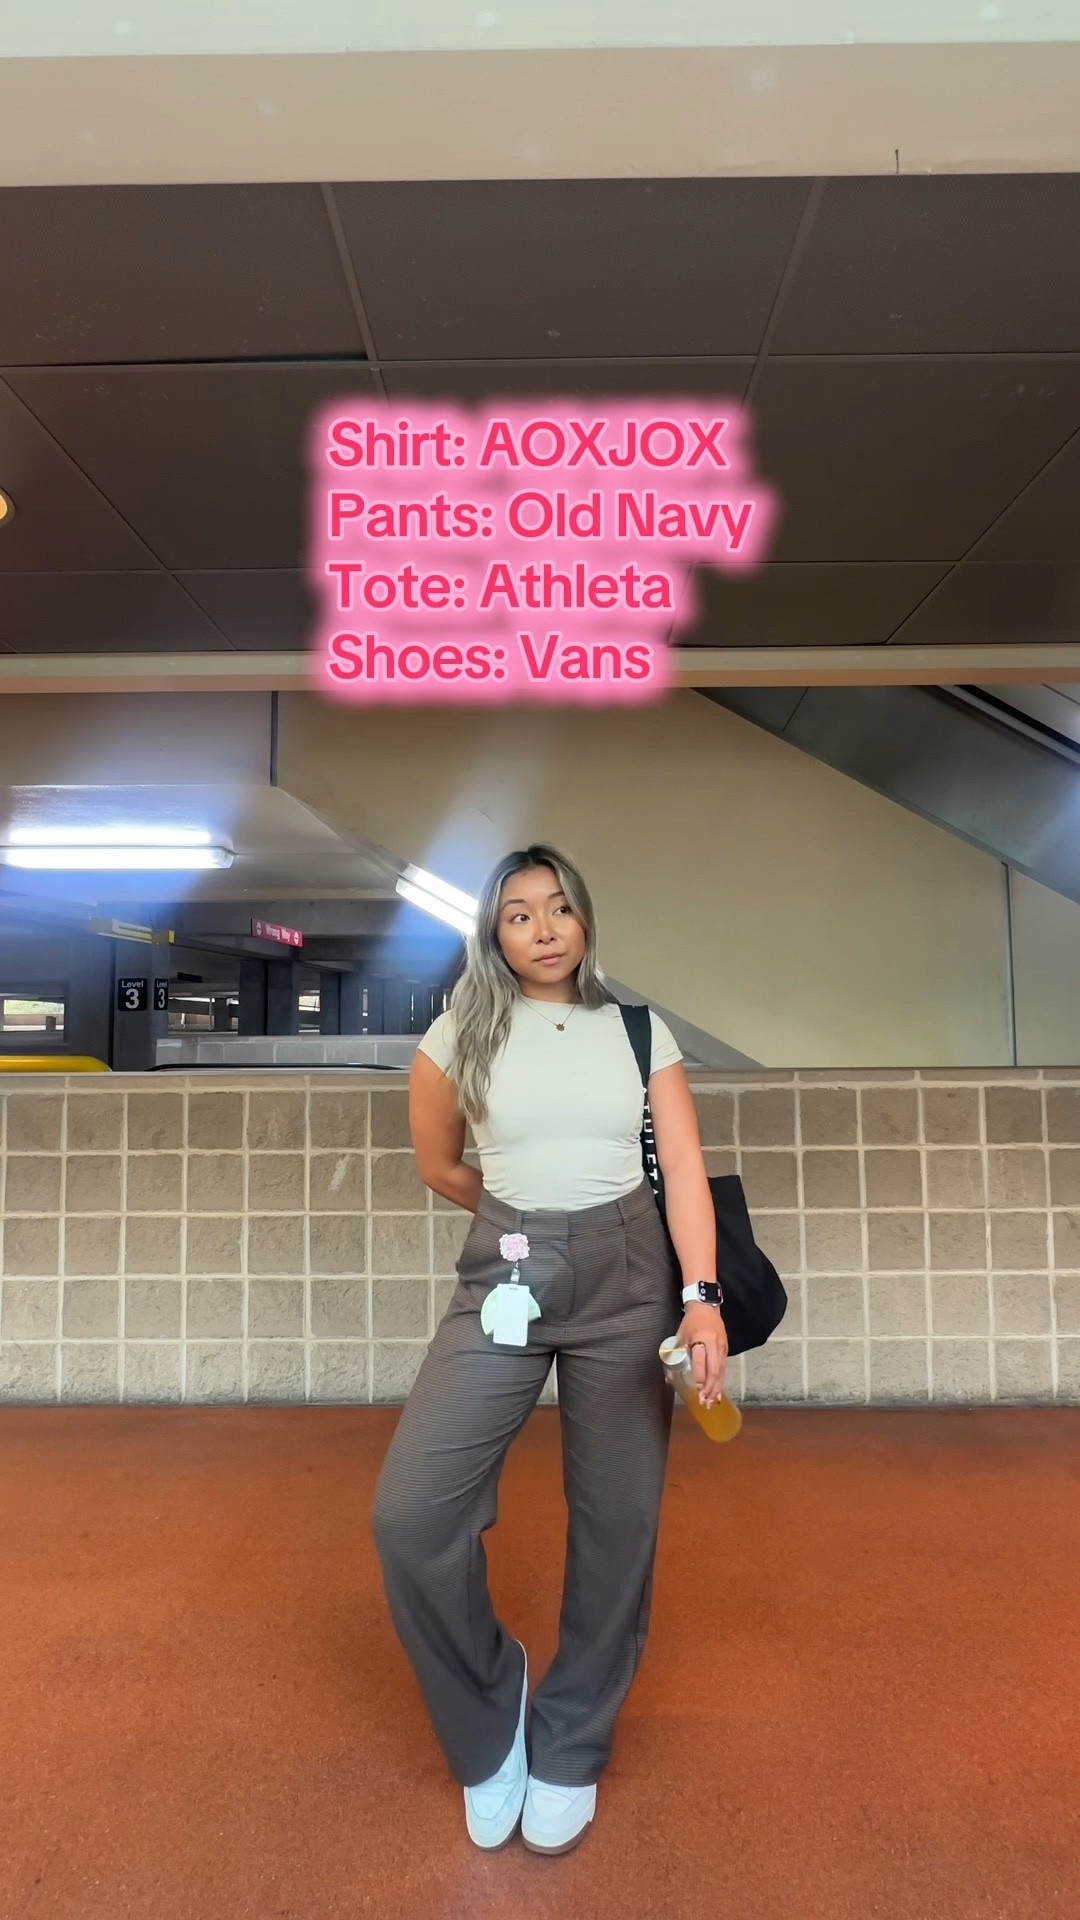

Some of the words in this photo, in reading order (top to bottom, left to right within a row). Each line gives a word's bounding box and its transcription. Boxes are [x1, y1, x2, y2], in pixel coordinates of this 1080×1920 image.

[121, 980, 144, 988] Level
[125, 988, 140, 1010] 3
[158, 988, 166, 1009] 3
